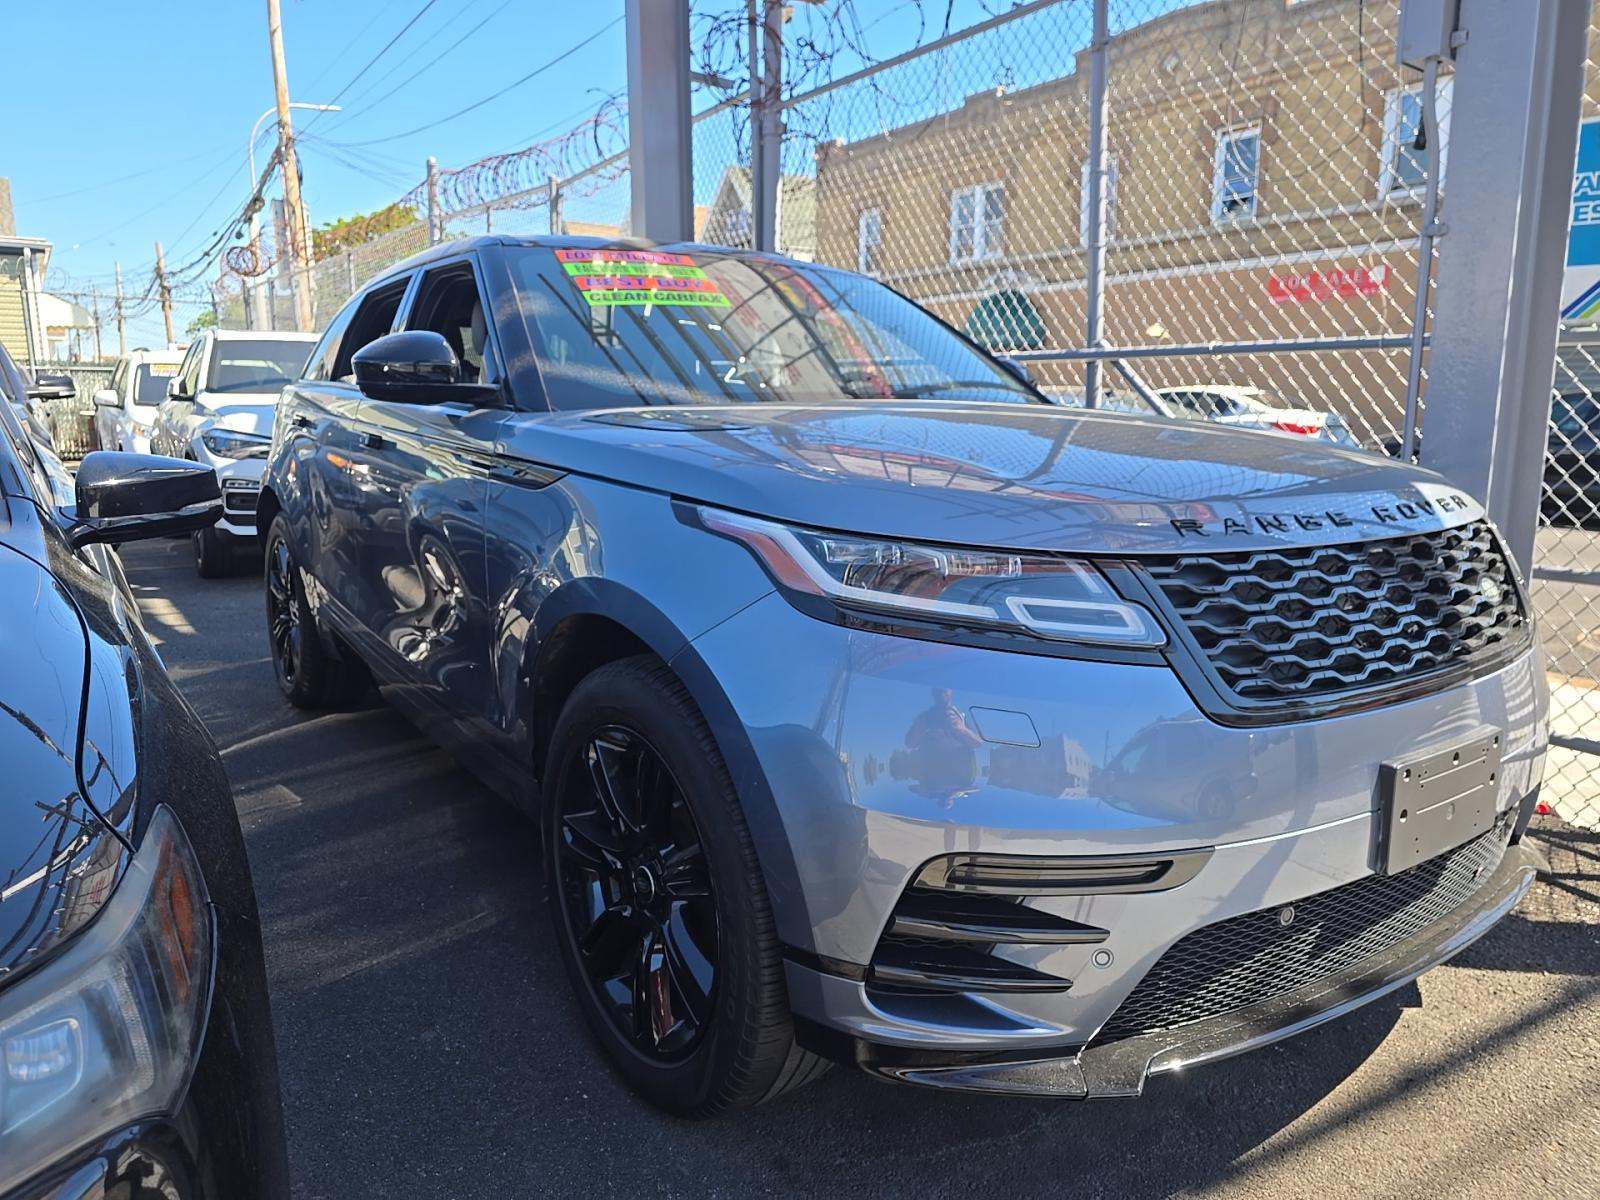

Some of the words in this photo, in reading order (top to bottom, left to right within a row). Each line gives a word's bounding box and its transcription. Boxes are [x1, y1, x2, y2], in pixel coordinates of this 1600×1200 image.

[585, 277, 645, 287] BEST
[657, 278, 702, 289] BUY
[589, 292, 648, 302] CLEAN
[654, 292, 724, 303] CARFAX
[1170, 511, 1354, 537] RANGE
[1371, 494, 1467, 523] ROVER
